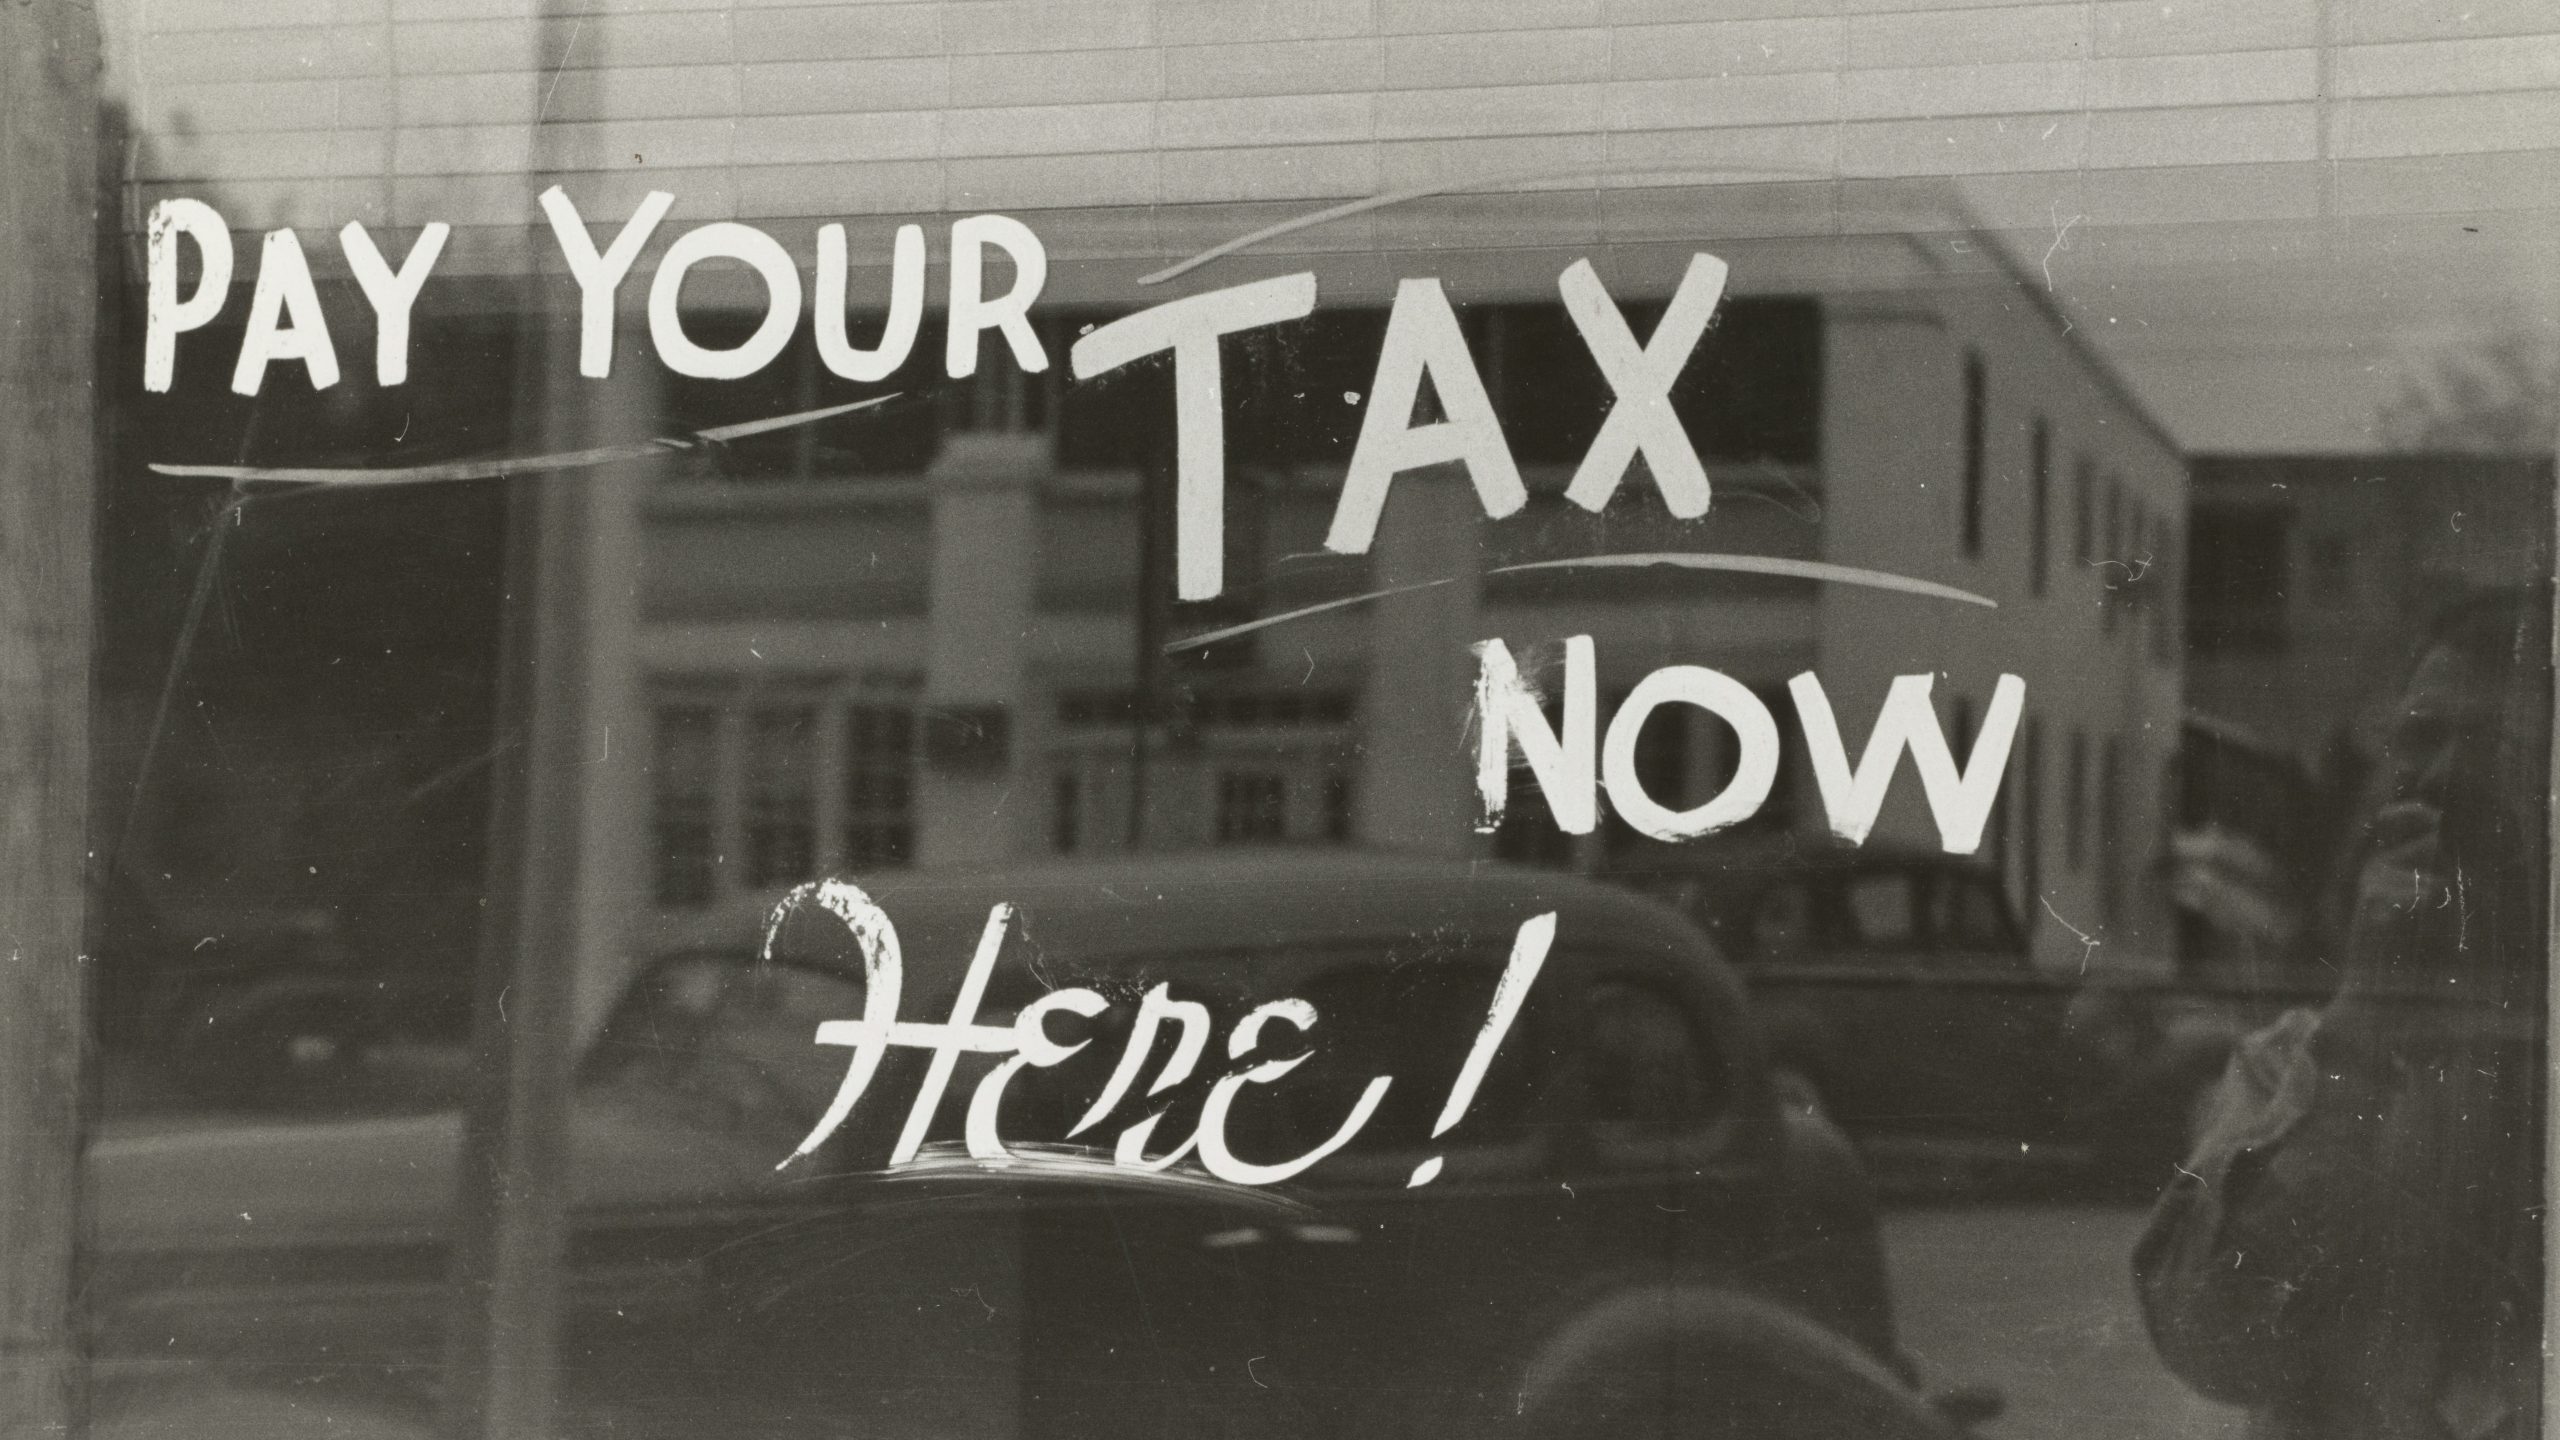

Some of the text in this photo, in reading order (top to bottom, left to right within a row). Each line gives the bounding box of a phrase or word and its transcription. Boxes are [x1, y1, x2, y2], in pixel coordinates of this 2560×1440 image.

[145, 185, 1048, 395] PAY YOUR
[1073, 253, 1727, 601] TAX
[1475, 634, 2025, 854] NOW
